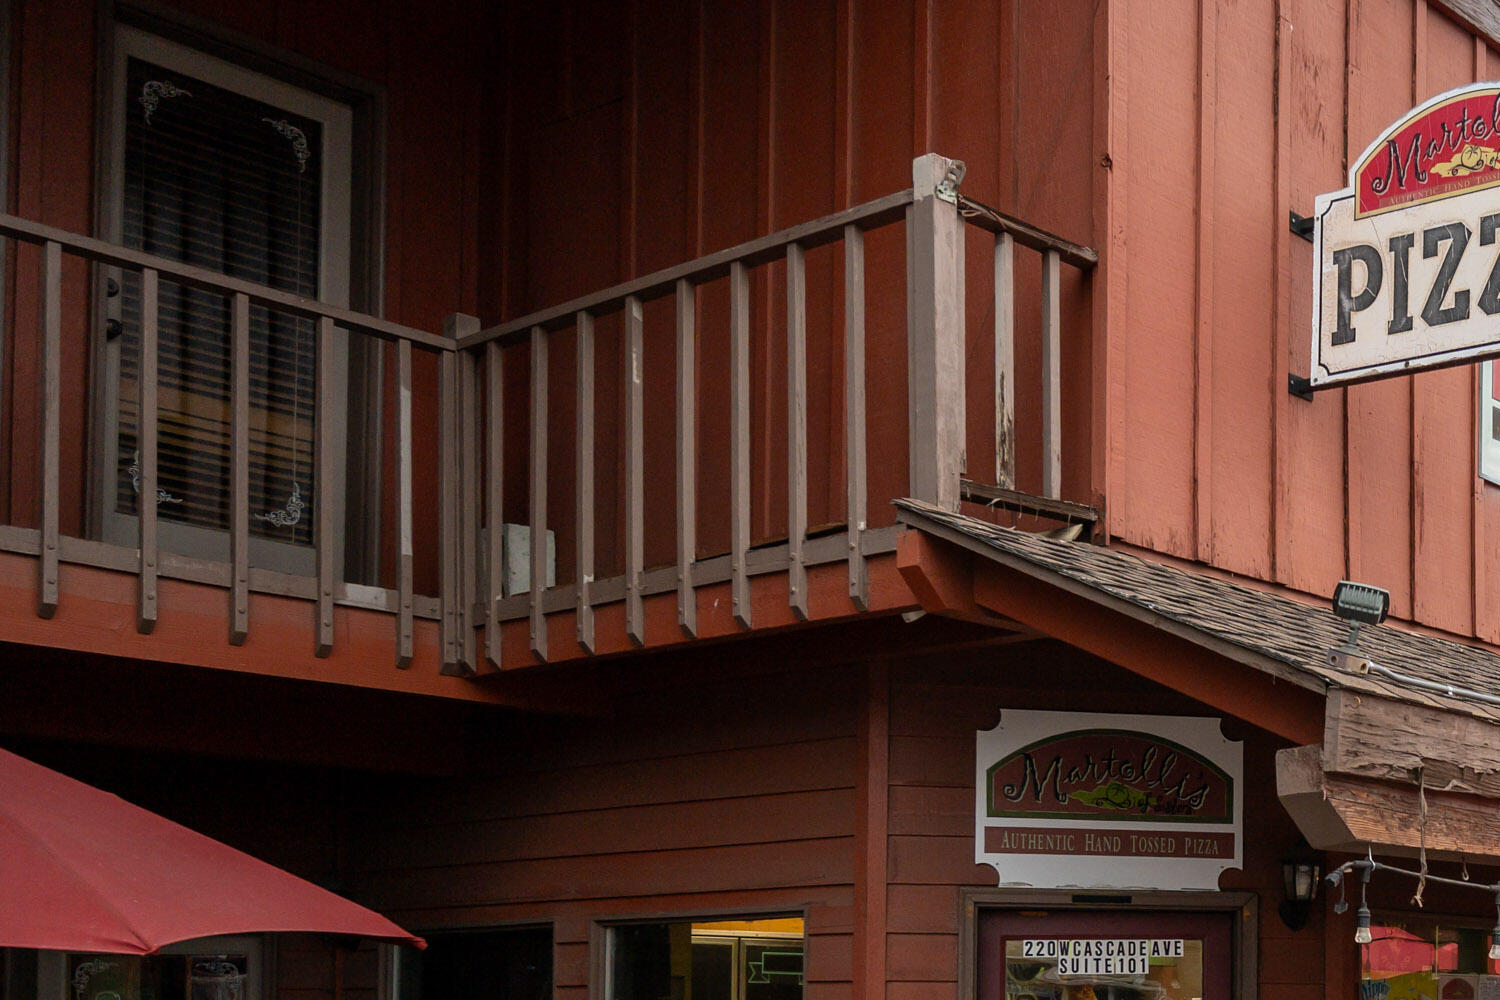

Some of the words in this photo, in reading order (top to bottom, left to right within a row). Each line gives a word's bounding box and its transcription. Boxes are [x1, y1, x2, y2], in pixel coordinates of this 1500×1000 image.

[1444, 180, 1471, 193] HAND
[1003, 744, 1210, 809] Martolli's
[1001, 830, 1075, 851] AUTHENTIC
[1085, 833, 1121, 853] HAND
[1130, 835, 1176, 855] TOSSED
[1184, 837, 1219, 855] PIZZA
[1024, 941, 1056, 957] 220
[1152, 940, 1182, 956] AVE
[1059, 958, 1113, 974] SUITE
[1118, 958, 1146, 974] 101
